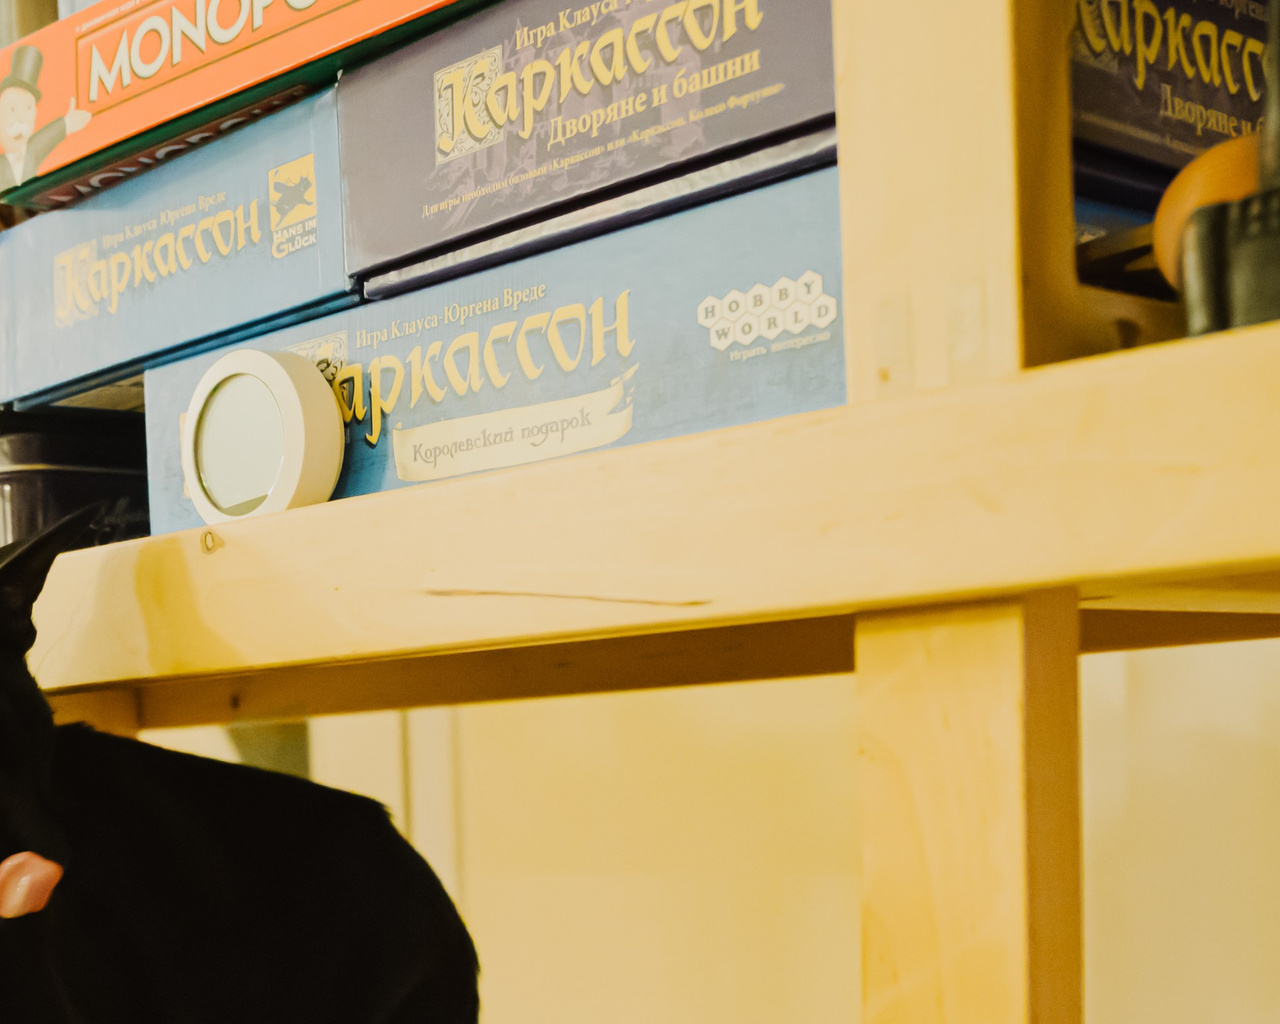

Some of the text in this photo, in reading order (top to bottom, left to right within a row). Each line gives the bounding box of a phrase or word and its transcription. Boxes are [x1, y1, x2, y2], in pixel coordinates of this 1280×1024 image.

[89, 0, 318, 103] MONOP
[515, 21, 556, 51] Игра
[436, 0, 764, 154] Каркассон
[547, 49, 762, 151] Дворяне и башни
[1158, 83, 1240, 138] Дворяне
[58, 198, 262, 322] Каркассон
[273, 217, 318, 241] HANS IM
[355, 283, 547, 350] Игра Клауса-Юргена Вреде
[704, 280, 816, 320] HOBBY
[715, 304, 829, 341] WORLD
[412, 407, 593, 469] Королевский подарок
